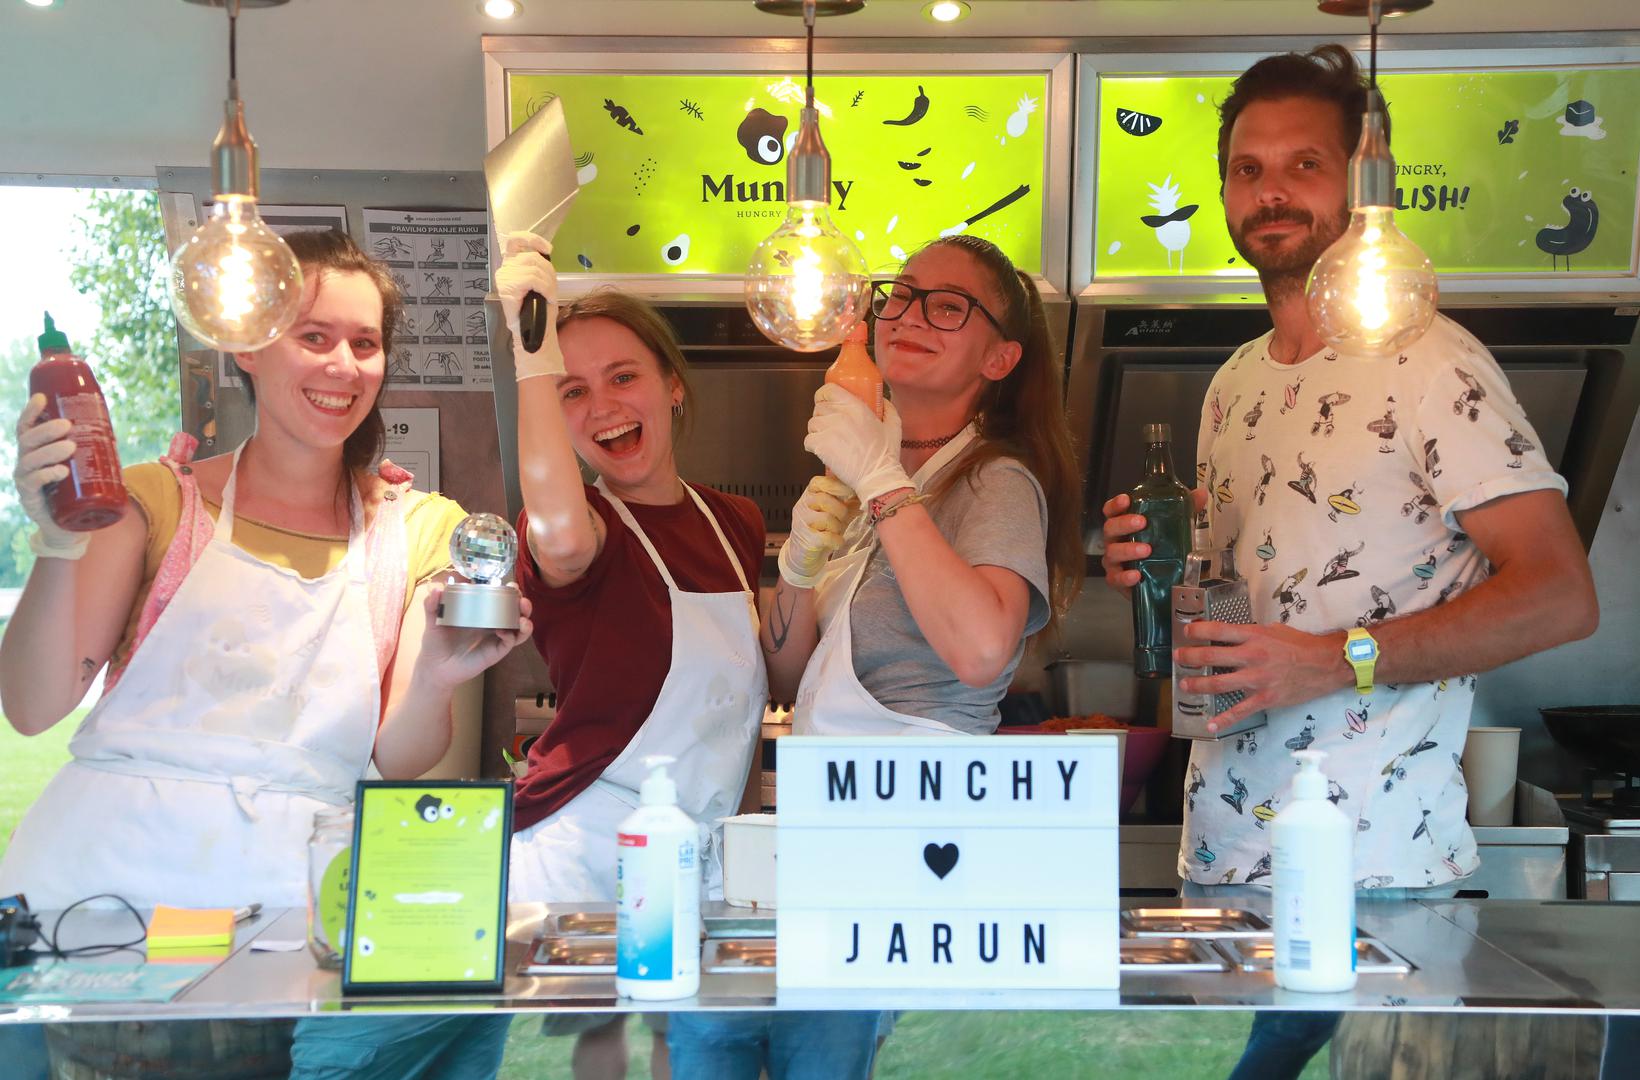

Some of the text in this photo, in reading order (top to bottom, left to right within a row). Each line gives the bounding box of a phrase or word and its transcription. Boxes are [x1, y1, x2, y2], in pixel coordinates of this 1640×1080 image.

[701, 174, 854, 211] Muny
[1395, 184, 1470, 212] LISH!
[391, 225, 427, 233] PRAVILNO
[737, 210, 782, 218] HUNGRY
[827, 760, 1078, 801] MUNCHY
[846, 923, 1046, 963] JARUN
